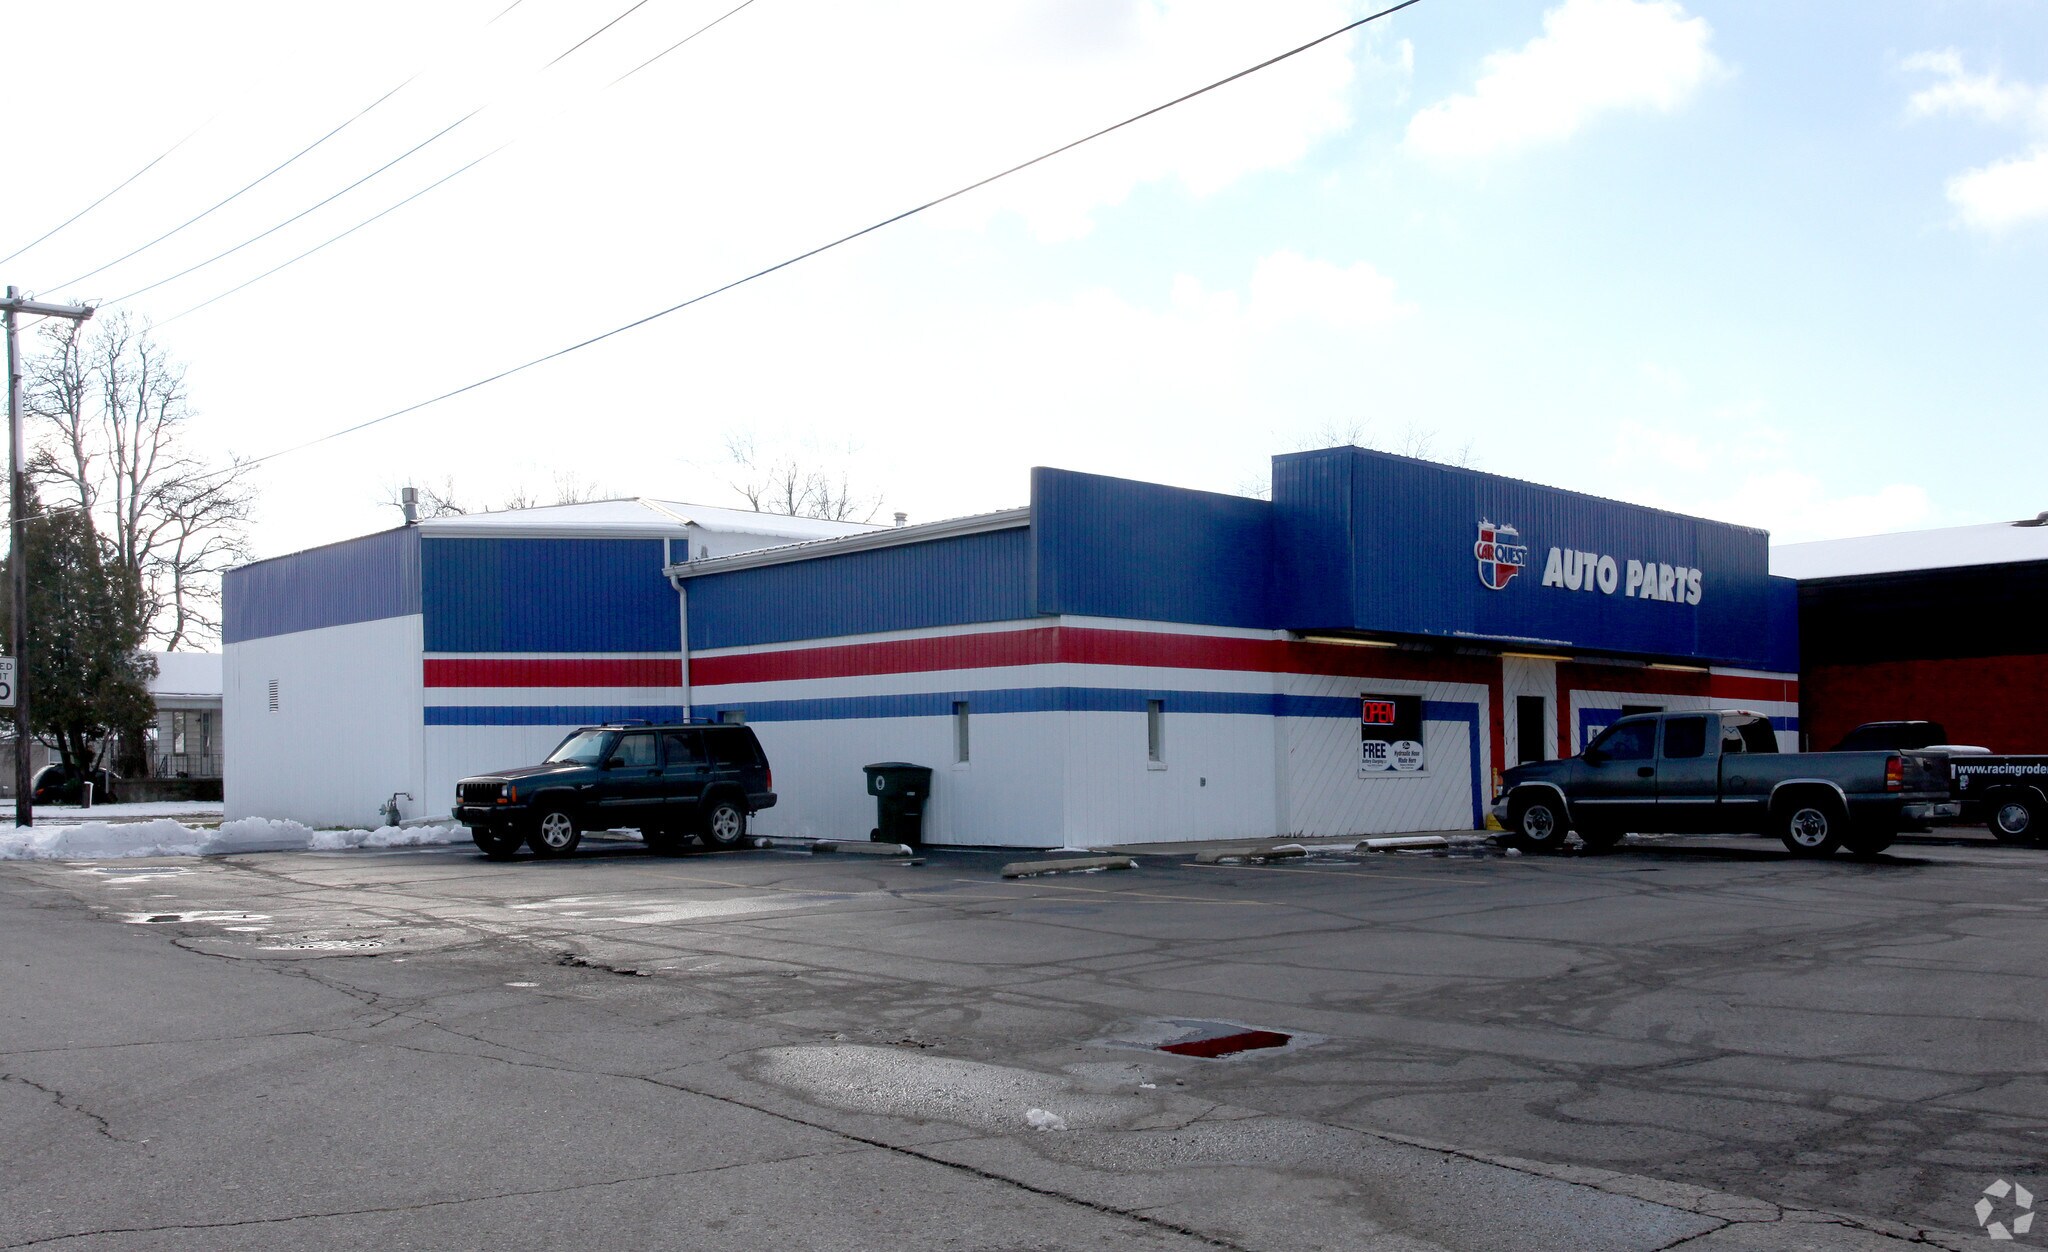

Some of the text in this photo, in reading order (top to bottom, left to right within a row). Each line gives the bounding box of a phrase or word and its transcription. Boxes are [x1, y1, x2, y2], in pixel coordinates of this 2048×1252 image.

[1542, 547, 1702, 606] AUTO PARTS
[1365, 703, 1394, 723] OPEN
[1363, 742, 1386, 758] FREE
[1957, 763, 2048, 776] www.racingrode
